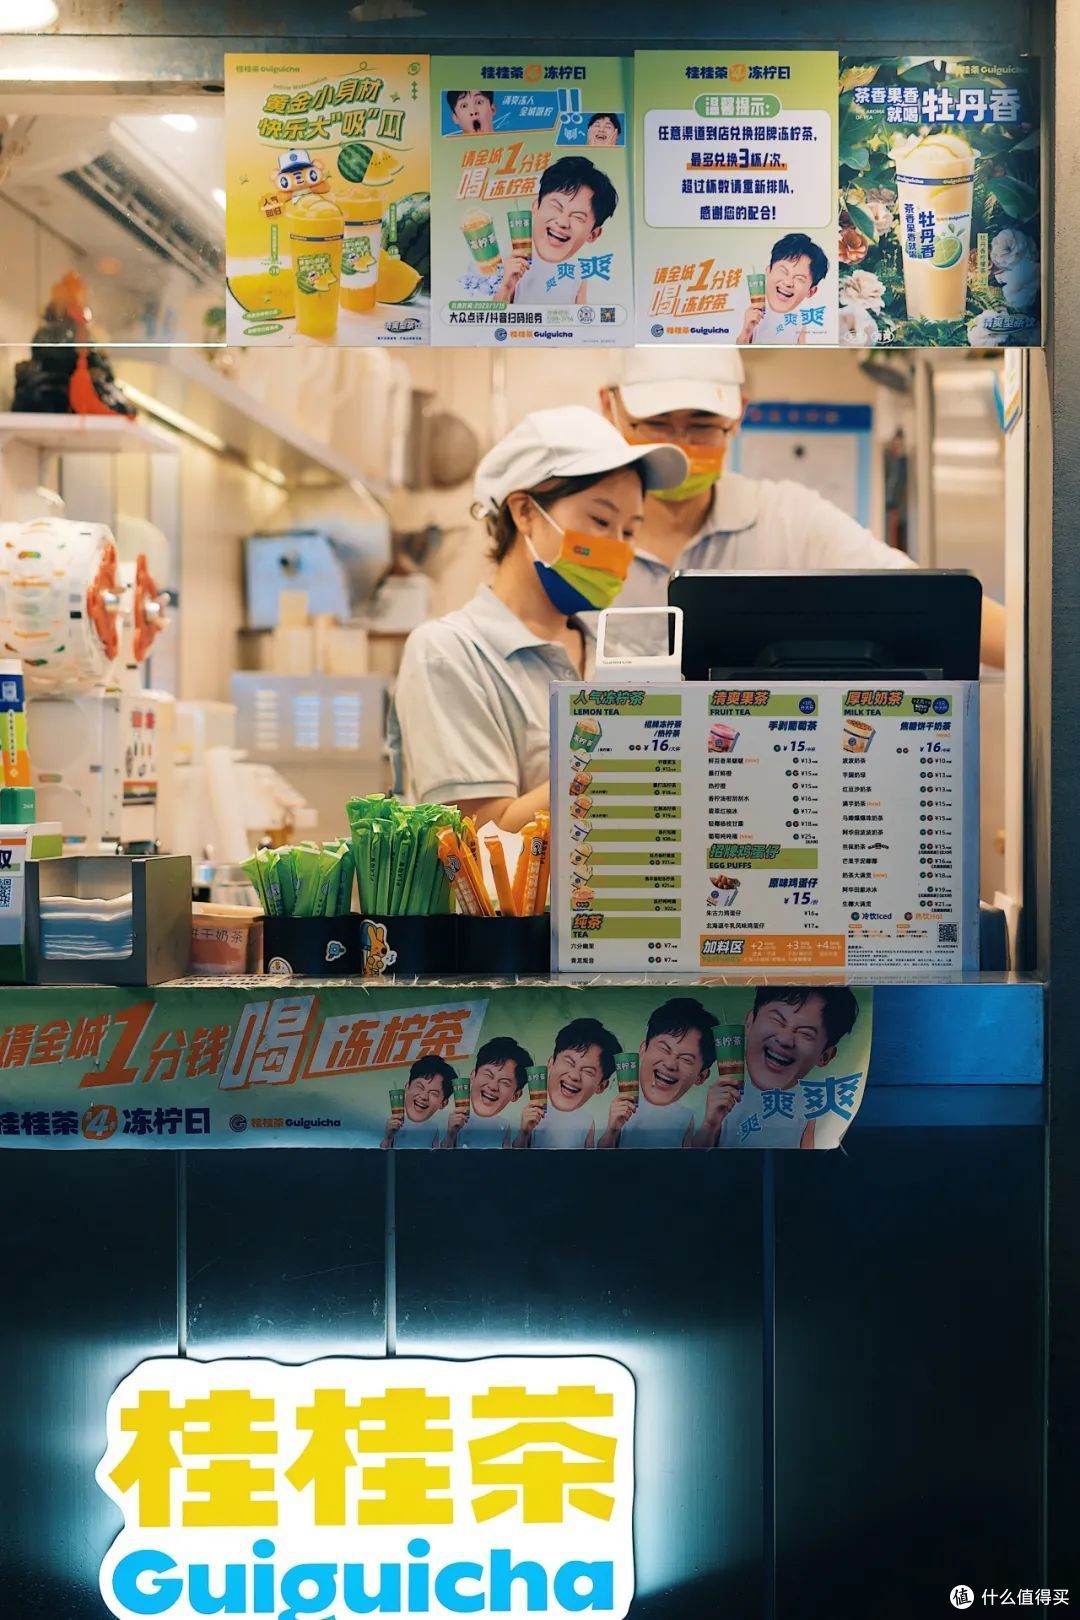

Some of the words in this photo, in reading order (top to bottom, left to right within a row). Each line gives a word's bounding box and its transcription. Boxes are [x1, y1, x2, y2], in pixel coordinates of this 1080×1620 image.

[481, 66, 523, 80] 桂桂茶
[544, 66, 586, 80] 冻柠日
[685, 66, 728, 80] 桂桂茶
[748, 66, 790, 80] 冻柠日
[263, 78, 384, 114] 黄金小身材
[854, 87, 919, 104] 茶香果香
[922, 87, 1021, 122] 牡丹香
[886, 106, 918, 123] 就喝
[918, 211, 936, 259] 牡丹香
[449, 312, 543, 324] 大众点评/抖音扫码抢券
[533, 330, 573, 340] Guiguicha
[690, 326, 729, 336] Guiguicha
[573, 690, 645, 706] 人气冻柠茶
[712, 690, 770, 706] 清爽果茶
[846, 690, 904, 706] 厚乳奶茶
[768, 721, 818, 731] 手剥葡萄茶
[709, 843, 781, 860] 招牌鸡蛋仔
[768, 878, 818, 888] 原味鸡蛋仔
[702, 940, 745, 954] 加料区
[122, 1107, 210, 1134] 冻柠日
[285, 1117, 341, 1129] Guiguicha
[108, 1386, 618, 1527] 桂桂茶
[112, 1538, 614, 1620] Guiguicha
